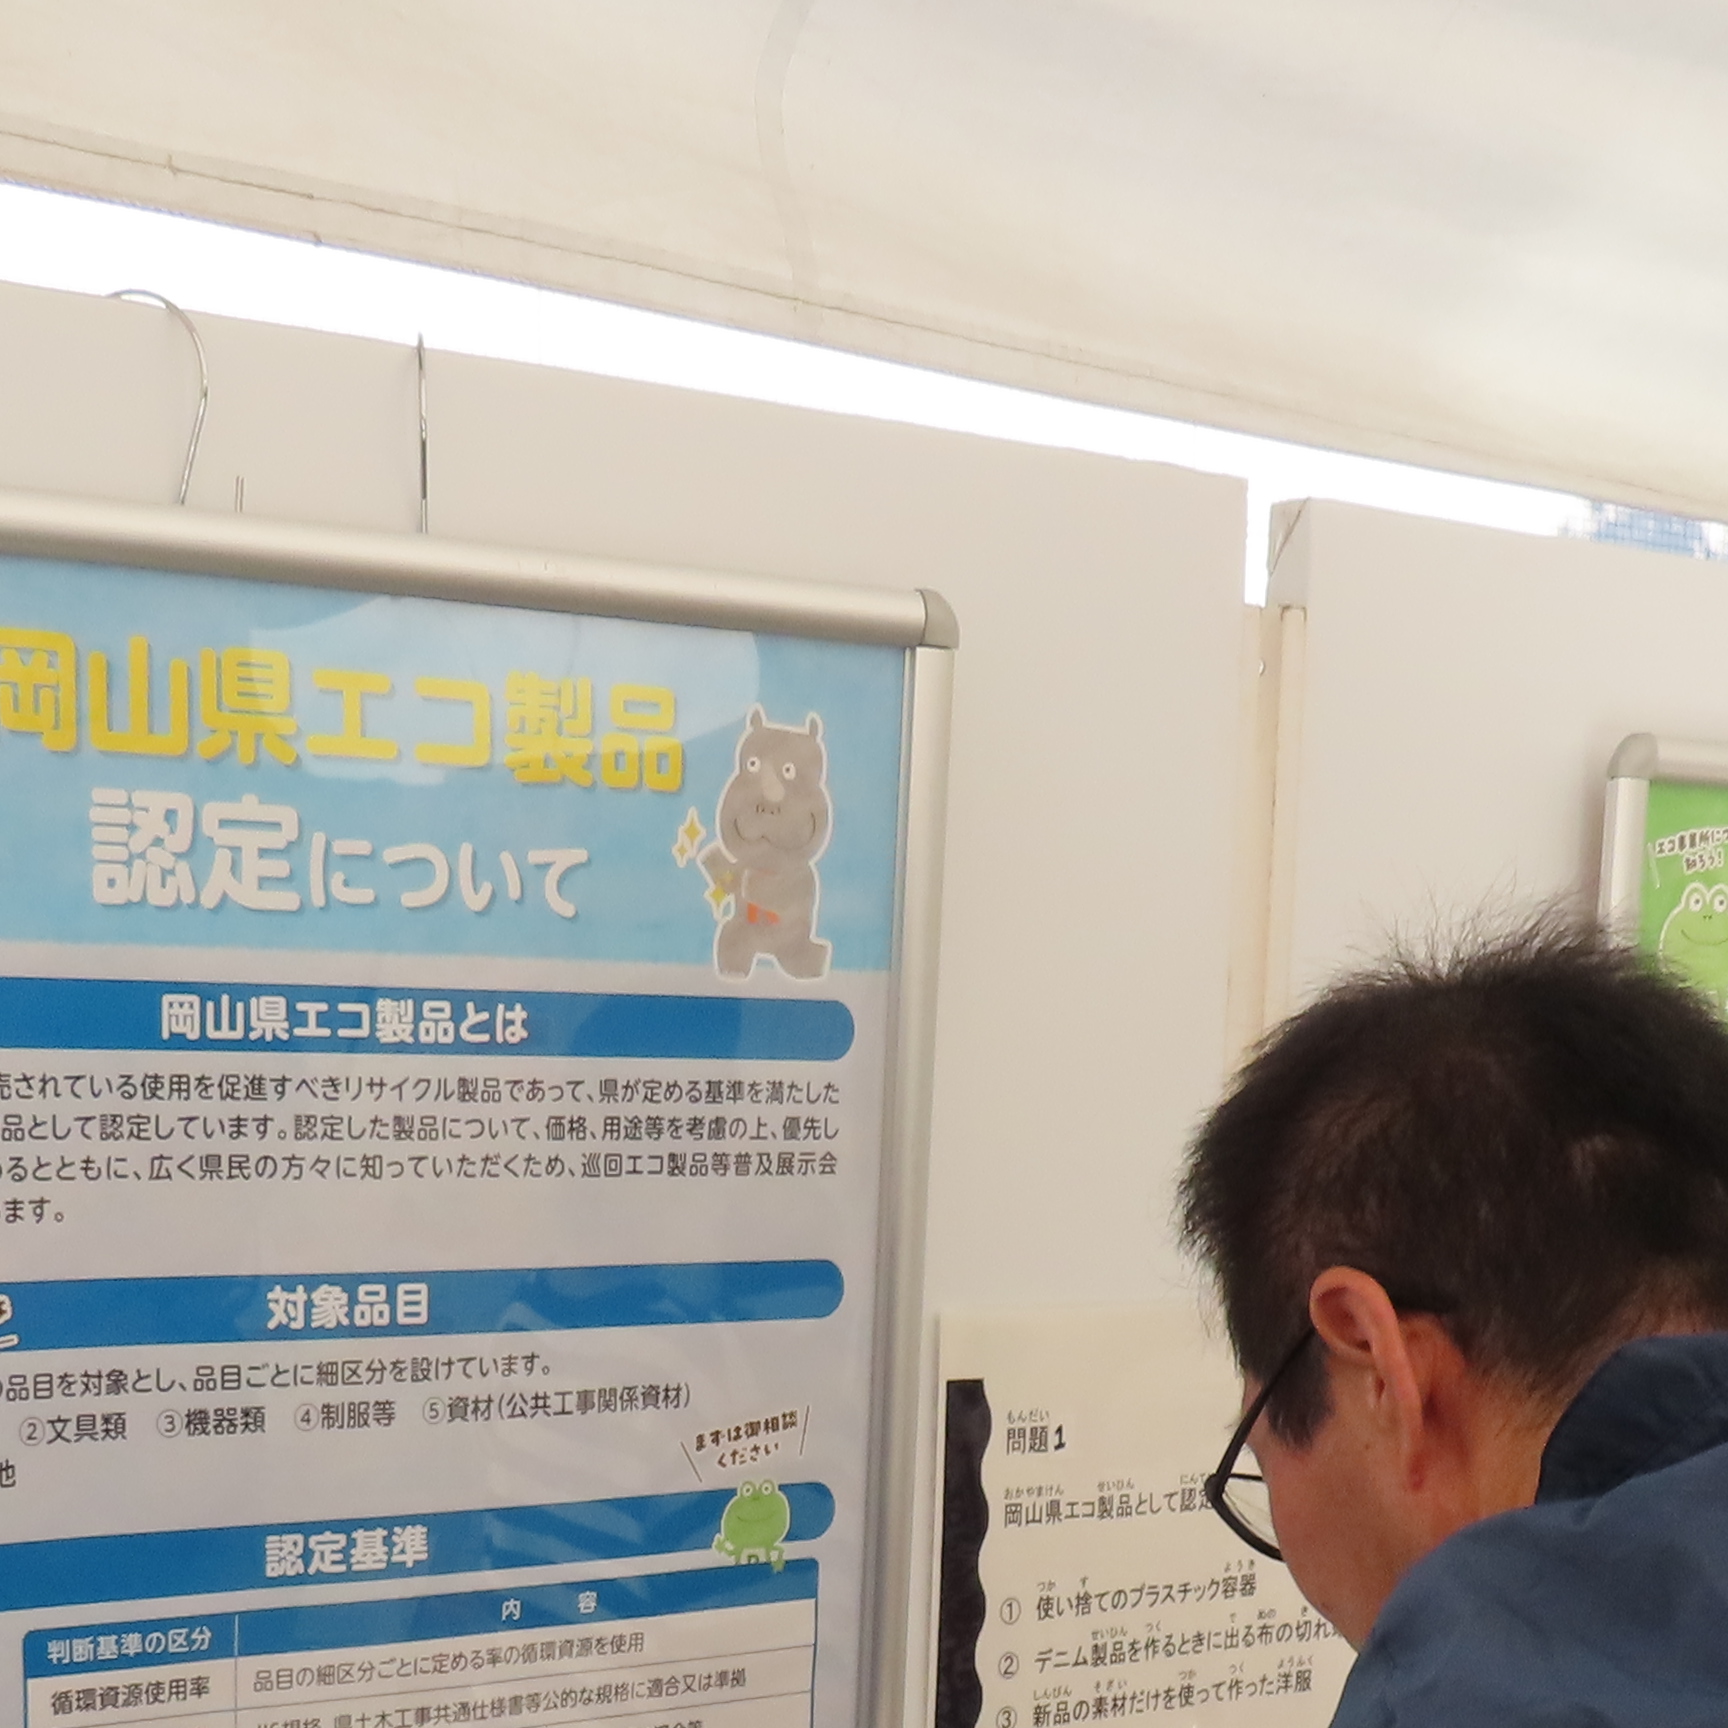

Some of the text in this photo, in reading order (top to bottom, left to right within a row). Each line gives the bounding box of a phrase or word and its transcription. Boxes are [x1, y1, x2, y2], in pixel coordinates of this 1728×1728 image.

[89, 786, 590, 920] 認定について
[160, 993, 530, 1051] 岡山県エコ製品とは
[265, 1281, 431, 1332] 対象品目
[18, 1410, 128, 1447] ②文具類
[156, 1405, 266, 1439] ③機器類
[292, 1402, 397, 1433] ④制服等
[694, 1409, 799, 1453] まずは御相談
[716, 1442, 780, 1469] ください
[264, 1525, 429, 1579] 認定基準
[1036, 1571, 1258, 1622] 使い捨てのプラスチック容器
[46, 1625, 213, 1665] 判断基準の区分
[252, 1631, 646, 1693] 品目の細区分ごとに定める率の循環資源を使用
[50, 1675, 211, 1717] 循環資源使用率
[1032, 1668, 1312, 1728] 新品の素材だけを使って作った洋服
